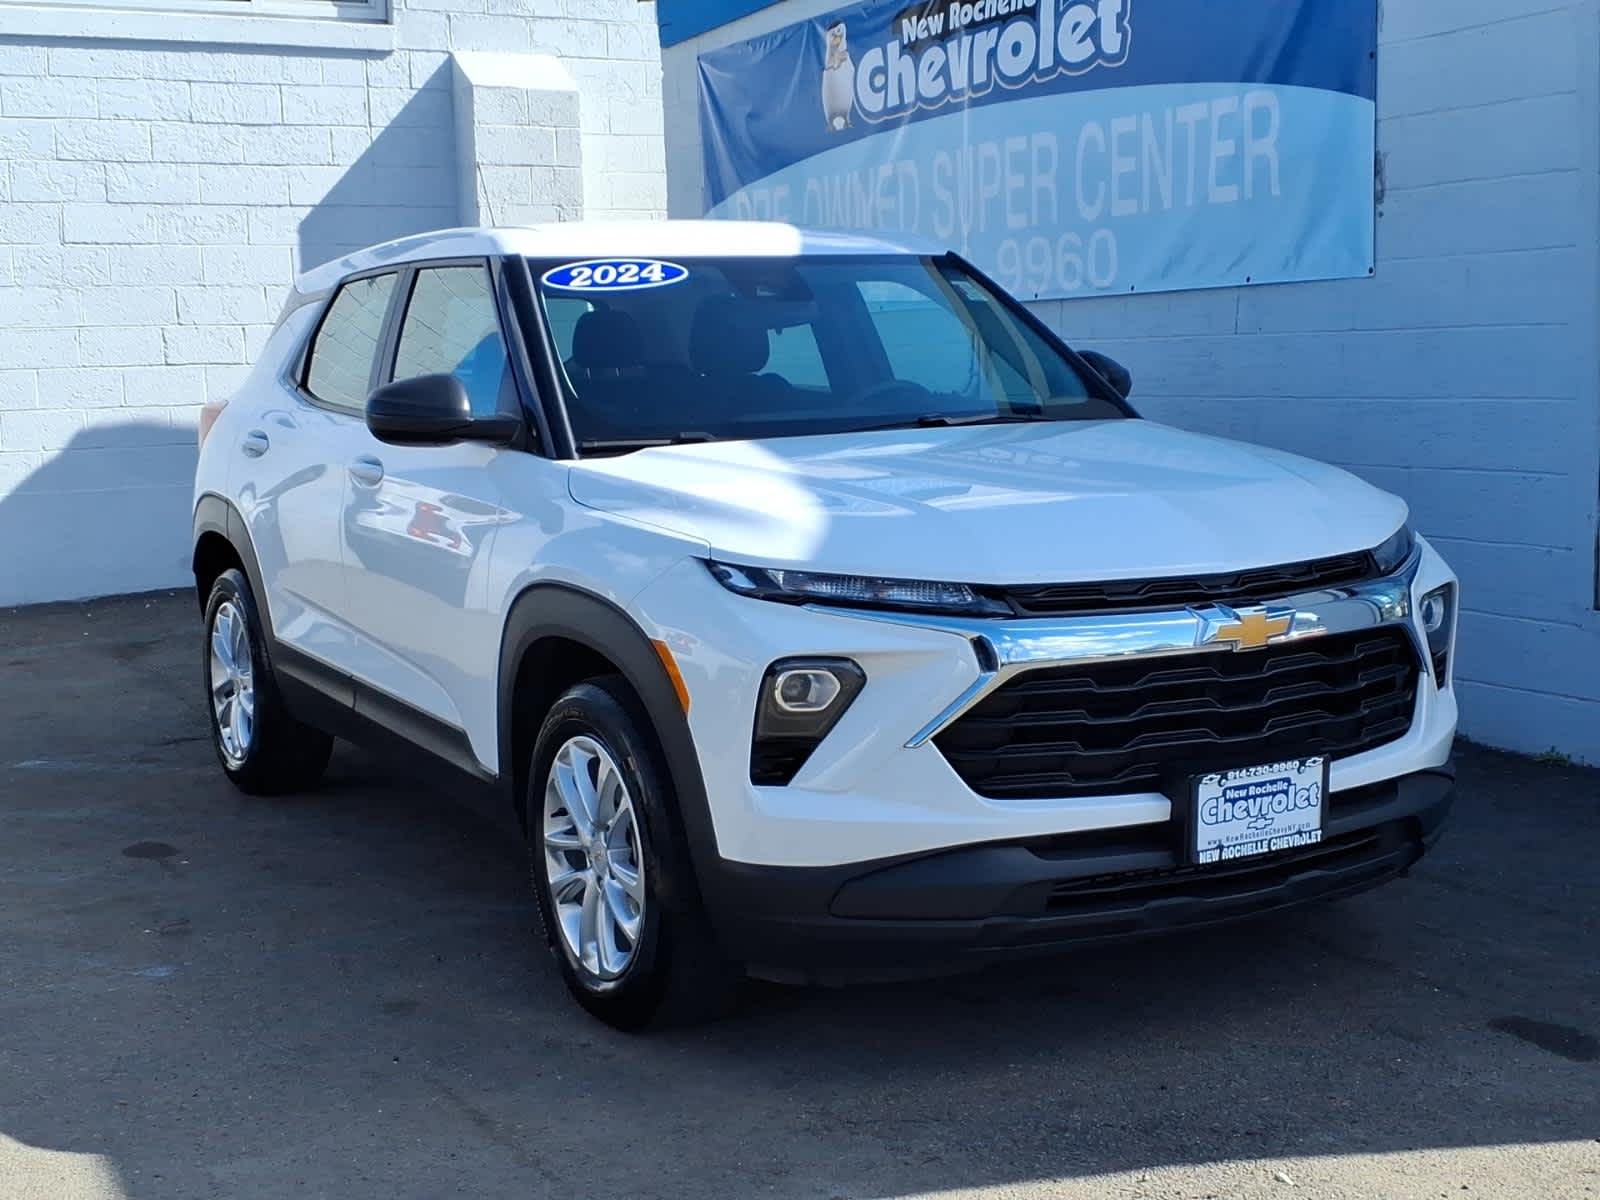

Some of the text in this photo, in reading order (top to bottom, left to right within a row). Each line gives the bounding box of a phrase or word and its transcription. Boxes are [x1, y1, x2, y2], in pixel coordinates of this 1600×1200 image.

[902, 12, 945, 44] New
[856, 0, 1124, 113] Chevrolet
[932, 89, 1281, 239] SUPER CENTER
[569, 263, 666, 288] 2024
[997, 228, 1118, 292] 9960
[1201, 782, 1320, 825] Chevrolet
[1225, 780, 1288, 801] New Rochelle
[1199, 829, 1322, 864] NEW ROCHELLE CHEVROLET
